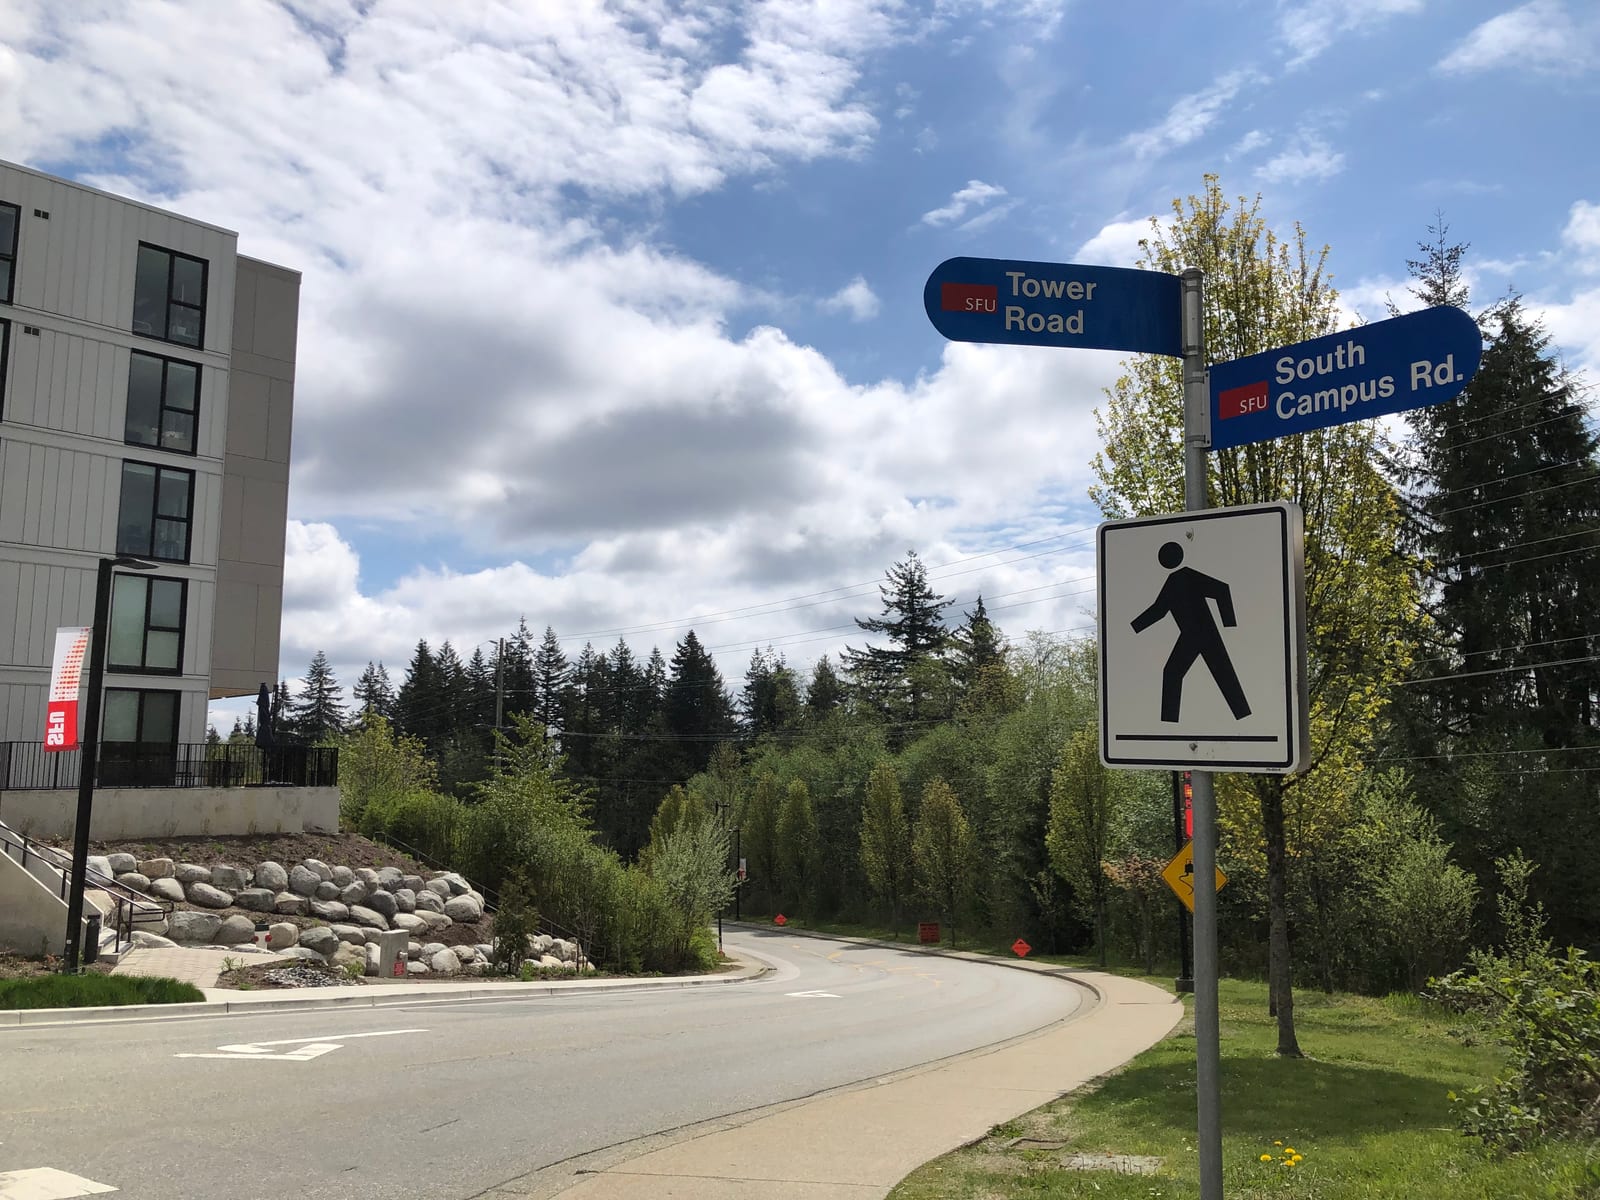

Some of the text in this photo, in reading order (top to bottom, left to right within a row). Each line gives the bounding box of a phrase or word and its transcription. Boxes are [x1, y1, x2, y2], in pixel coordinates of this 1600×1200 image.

[1005, 271, 1097, 301] Tower
[964, 297, 996, 312] SFU
[1005, 305, 1084, 334] Road
[1276, 340, 1366, 385] South
[1276, 354, 1464, 420] Campus Rd.
[1239, 395, 1267, 414] SFU
